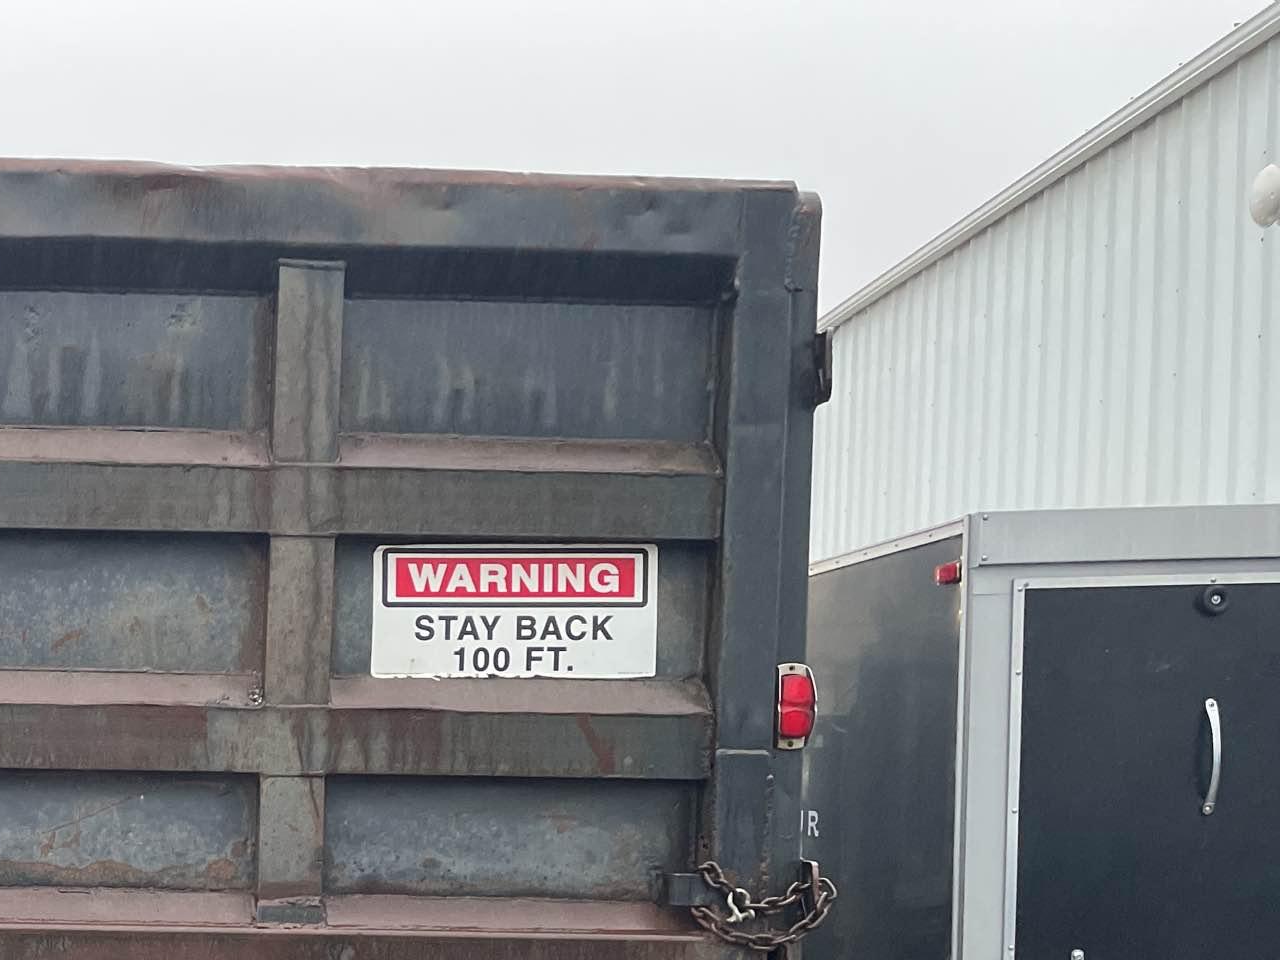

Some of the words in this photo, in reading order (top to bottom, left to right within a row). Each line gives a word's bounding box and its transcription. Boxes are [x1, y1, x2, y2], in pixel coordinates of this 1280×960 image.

[408, 563, 620, 592] WARNING
[415, 614, 501, 641] STAY
[516, 614, 614, 641] BACK
[454, 647, 510, 672] 100
[525, 647, 573, 672] FT.
